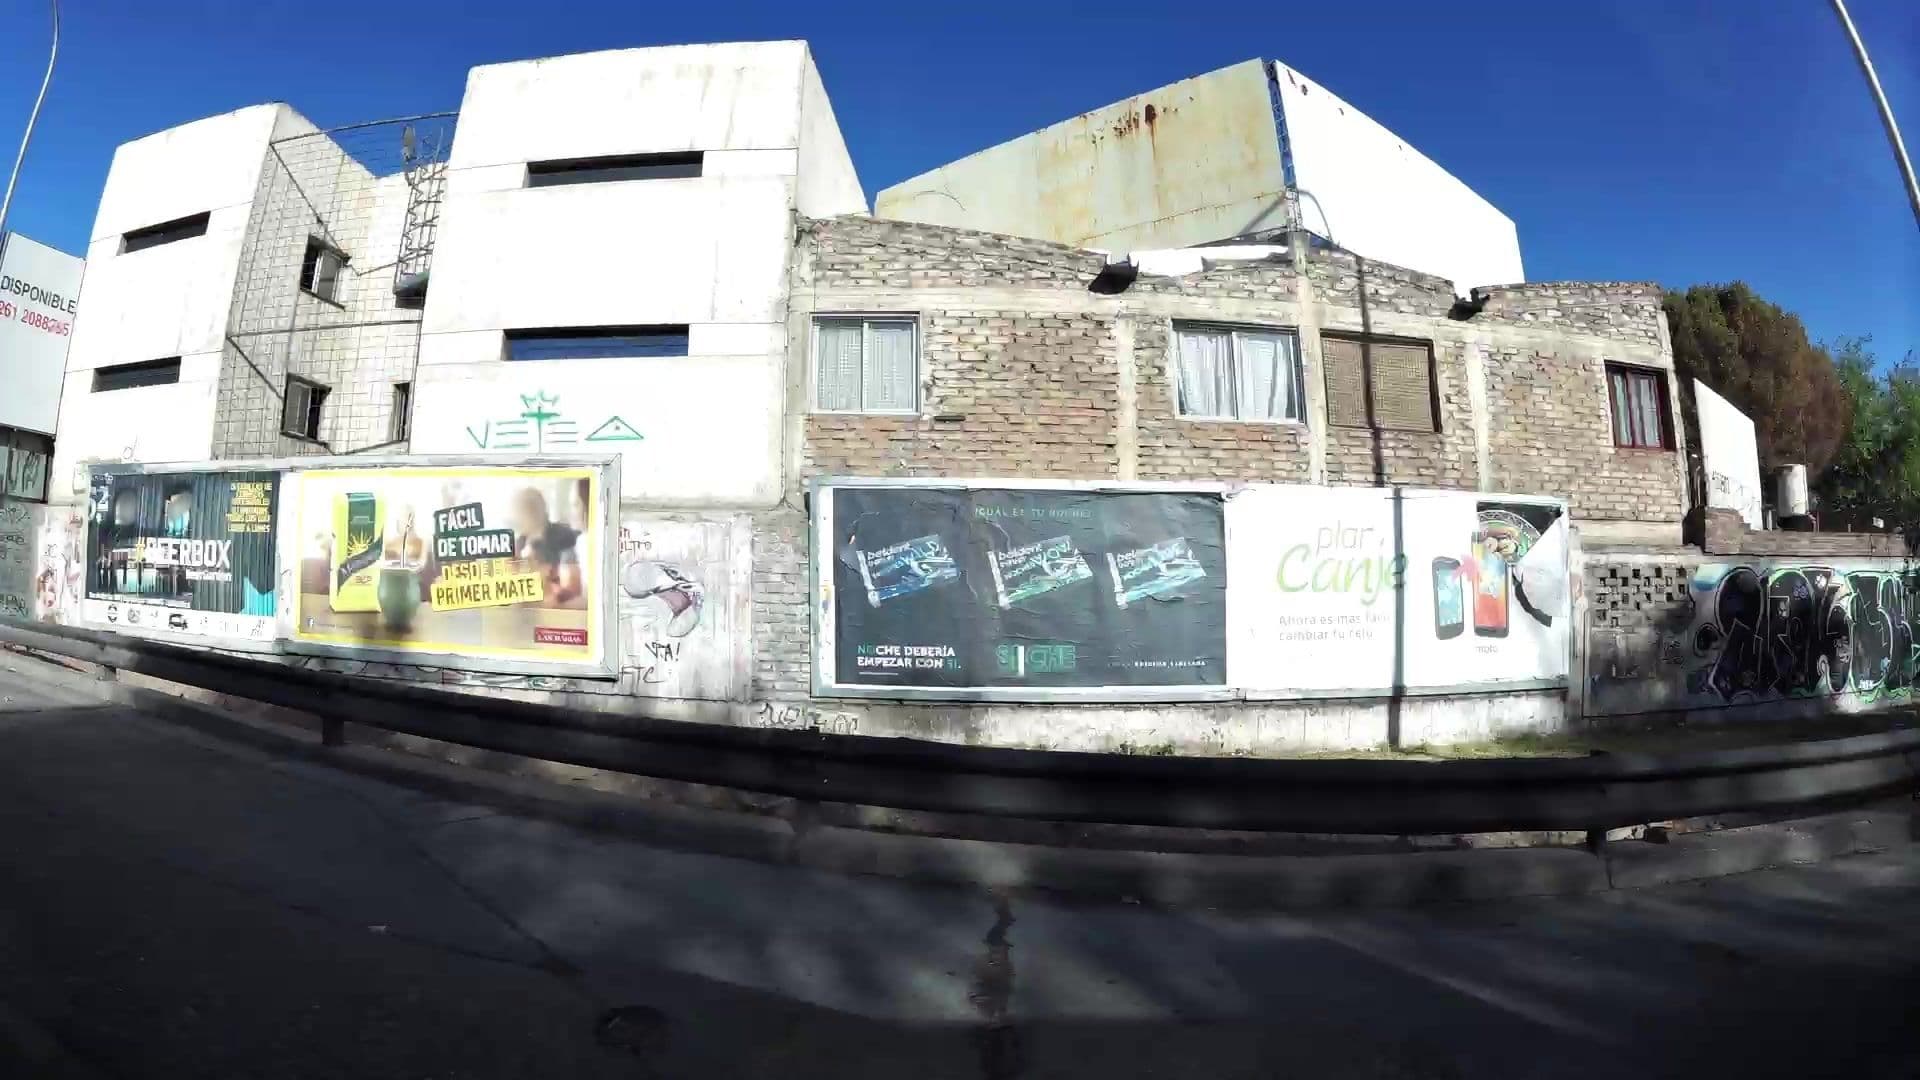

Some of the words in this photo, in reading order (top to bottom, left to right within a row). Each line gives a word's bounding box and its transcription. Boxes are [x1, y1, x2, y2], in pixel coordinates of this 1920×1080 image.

[1, 275, 76, 315] DISPONIBLE
[438, 507, 481, 533] FÁCIL
[437, 537, 457, 558] DE
[459, 533, 513, 556] TOMAR
[1277, 539, 1408, 606] Canje
[436, 583, 491, 606] PRIMER
[495, 578, 536, 600] MATE
[1319, 616, 1334, 625] es
[857, 657, 913, 668] EMPEZAR
[903, 645, 956, 657] DEBERÍA
